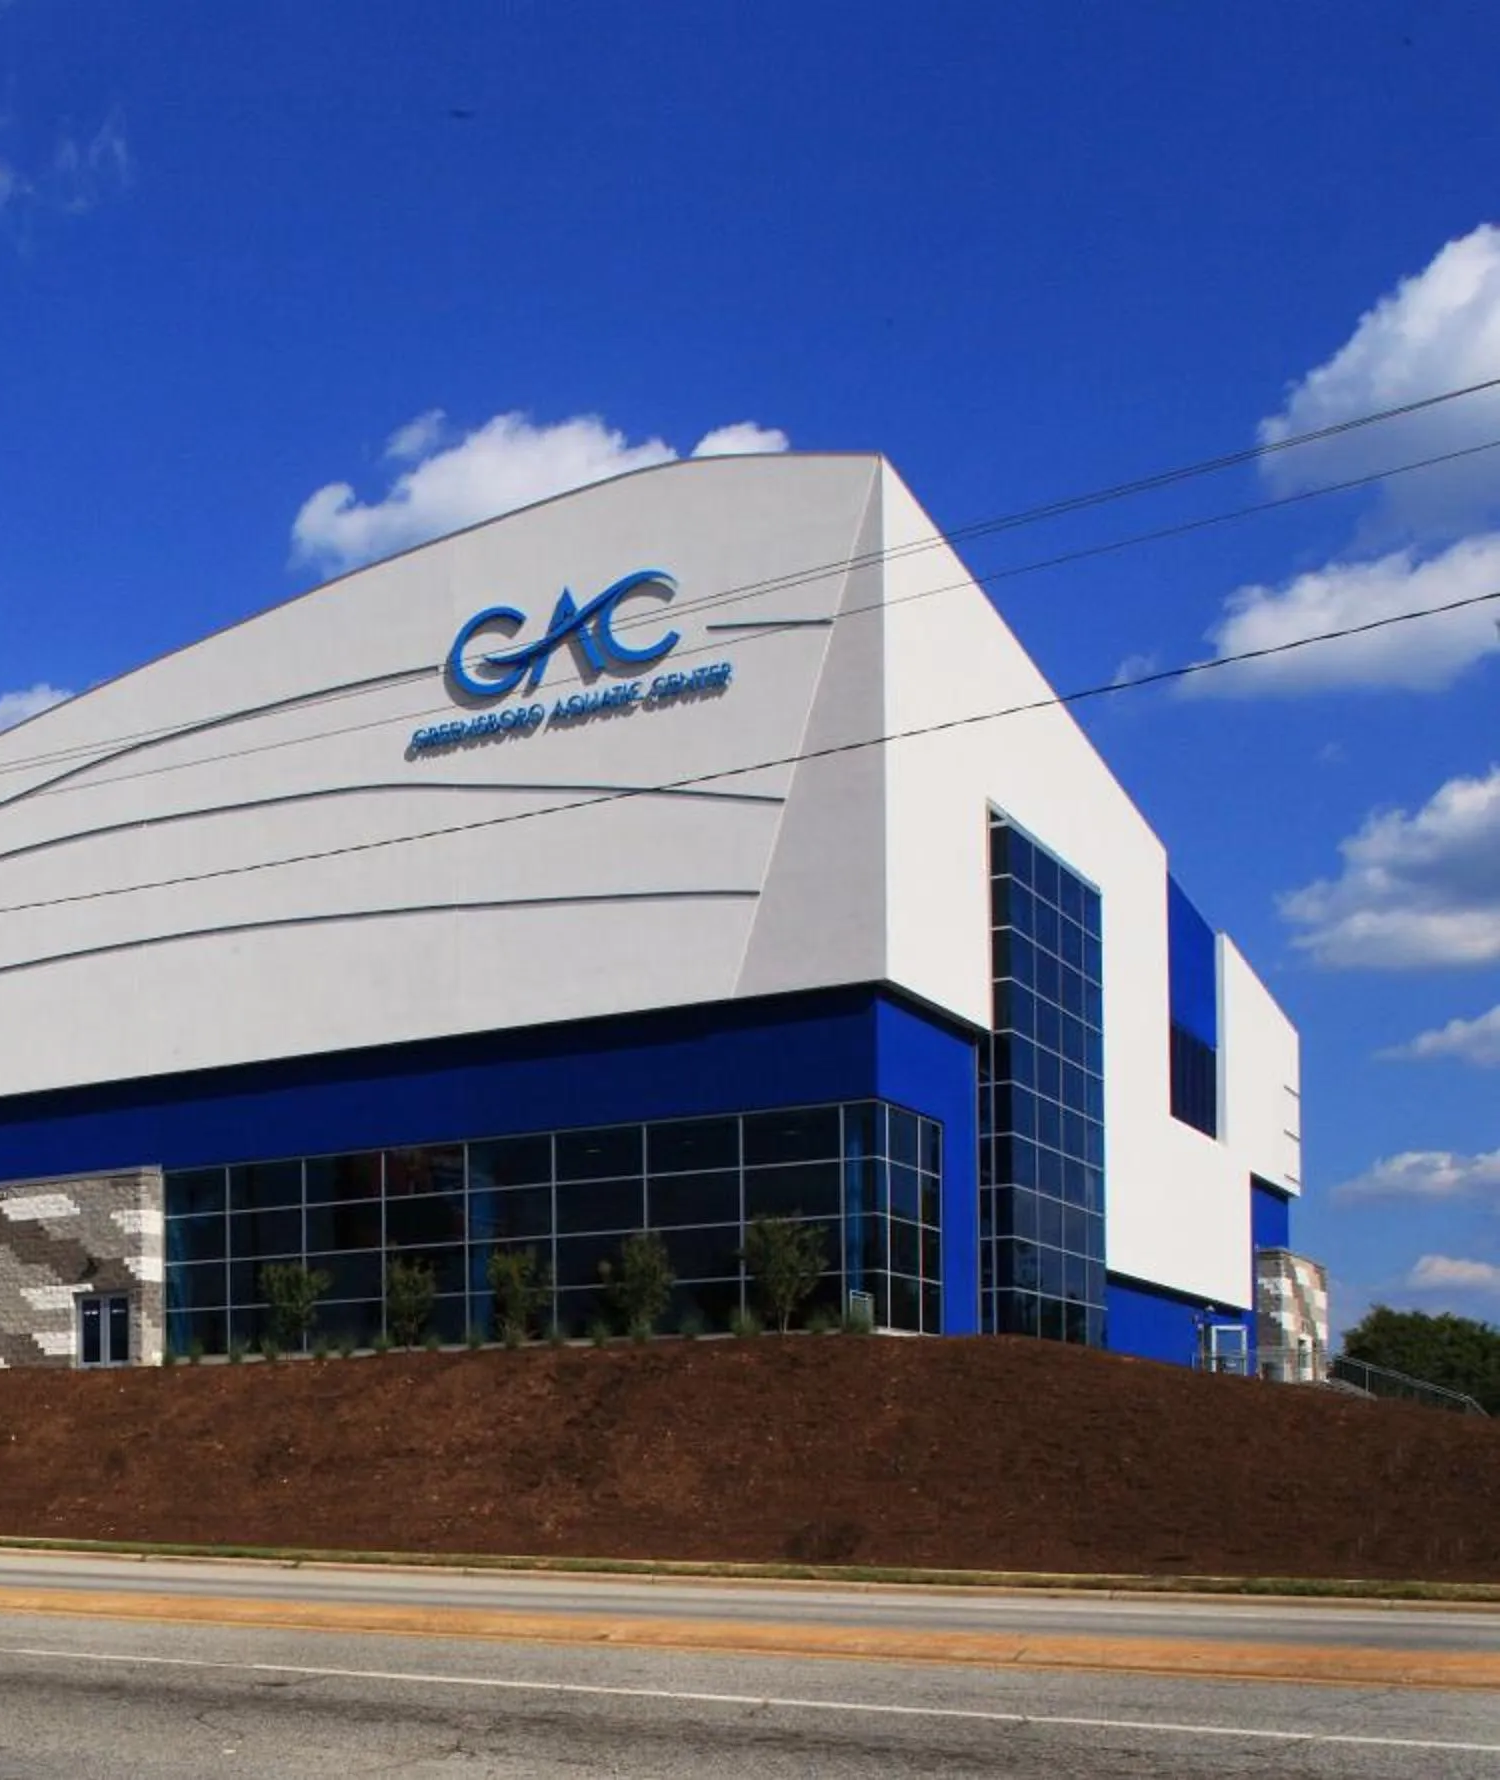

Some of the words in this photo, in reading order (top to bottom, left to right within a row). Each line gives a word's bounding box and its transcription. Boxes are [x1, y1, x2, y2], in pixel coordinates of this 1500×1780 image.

[451, 569, 680, 695] GAC
[412, 704, 544, 749] GREENSBORO
[551, 682, 641, 720] AQUATIC
[651, 662, 732, 697] CENTER
